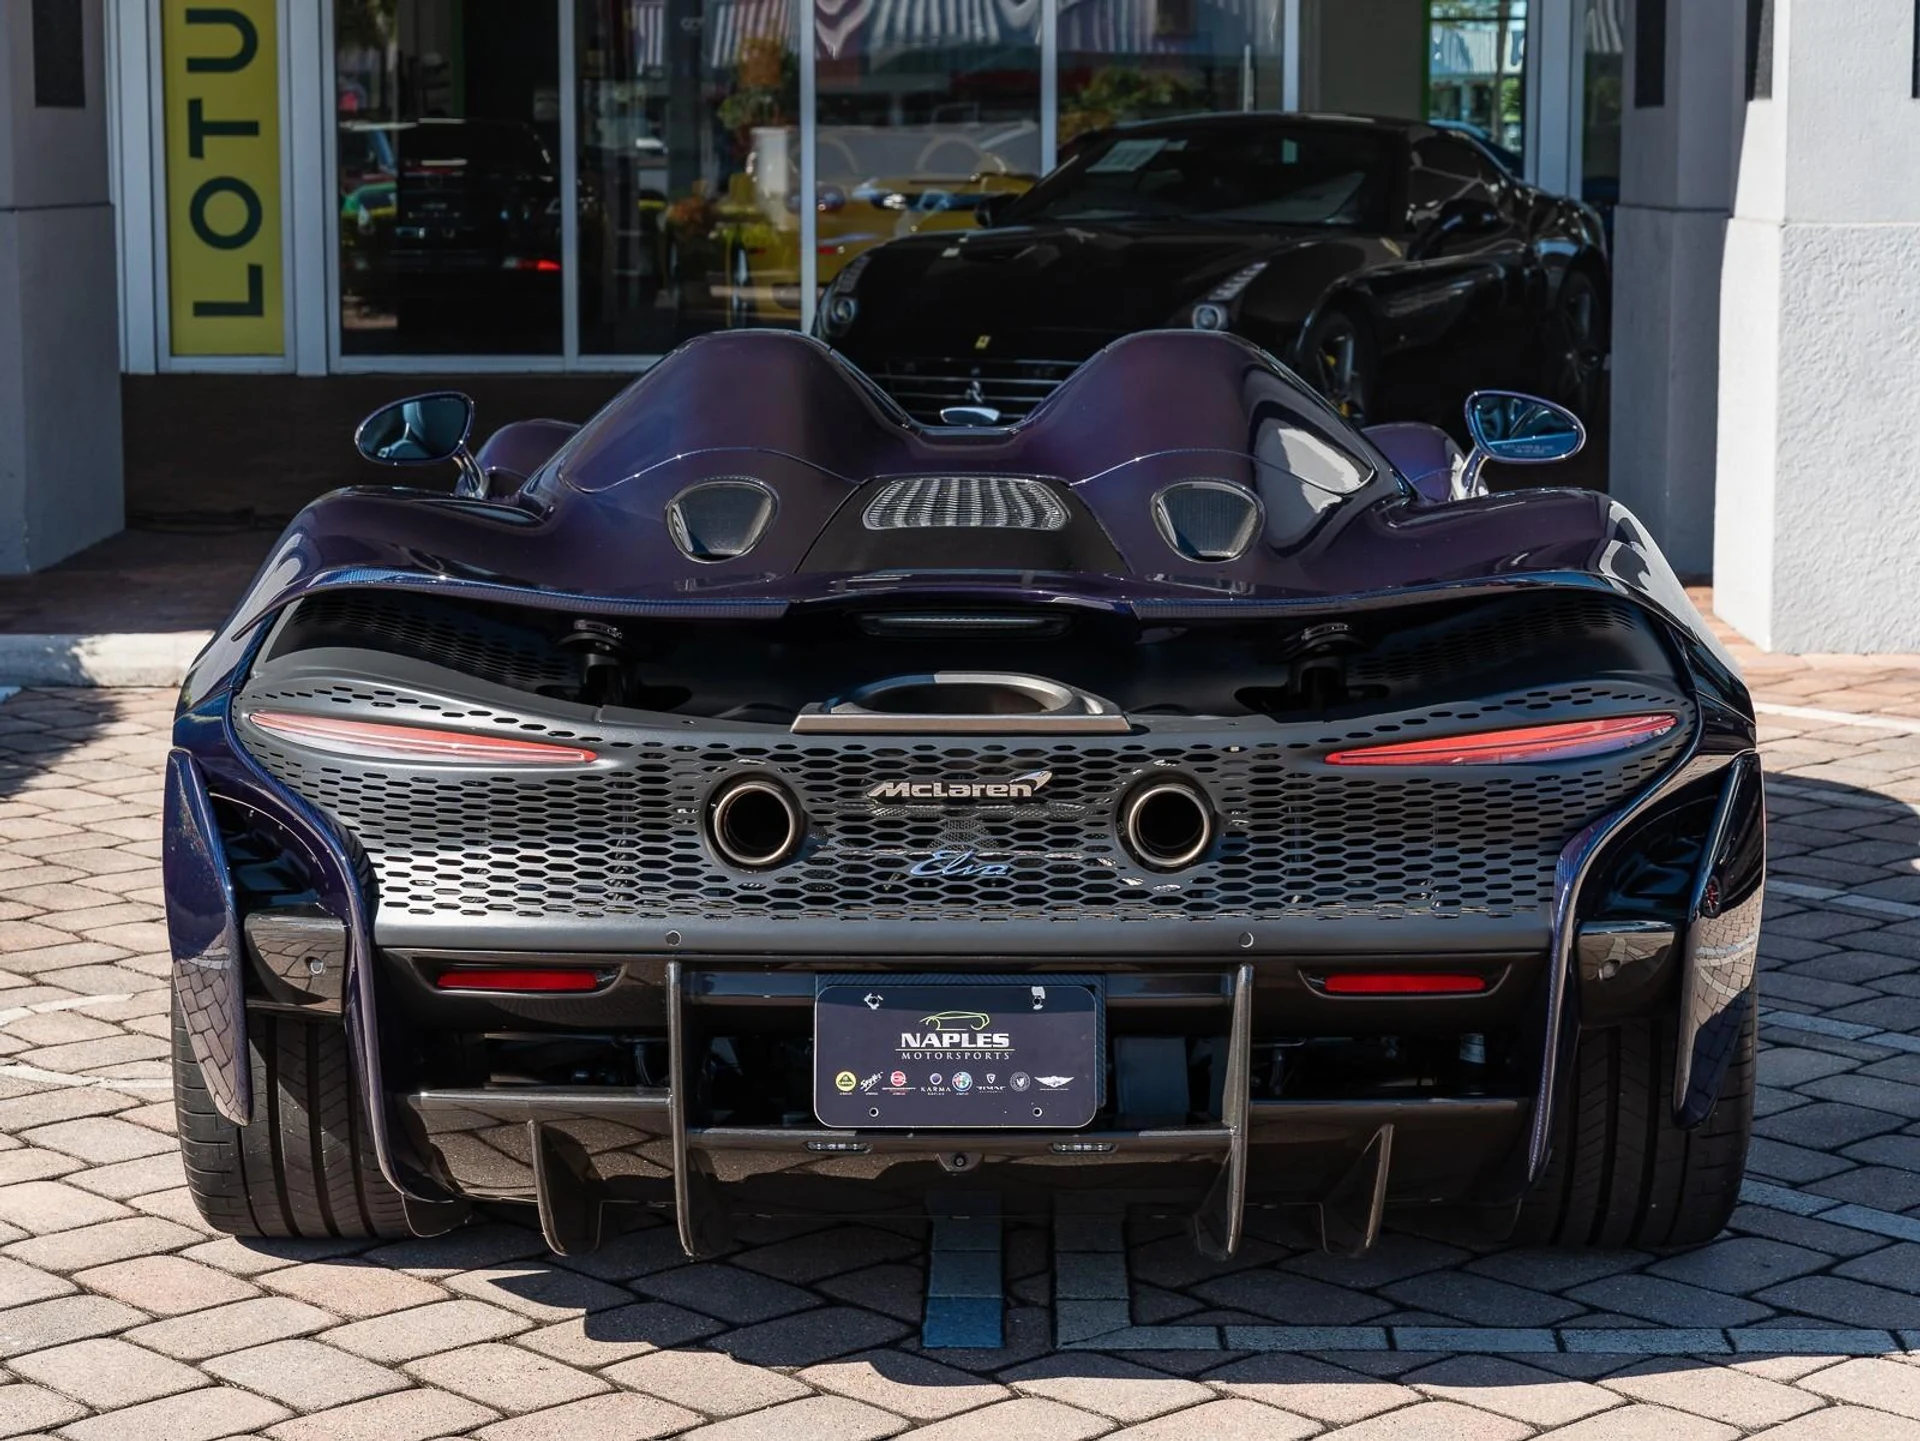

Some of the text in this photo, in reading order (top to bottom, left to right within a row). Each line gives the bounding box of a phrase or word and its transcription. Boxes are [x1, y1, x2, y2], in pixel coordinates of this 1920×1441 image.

[866, 782, 1032, 797] McLaren
[911, 849, 1011, 877] Elva
[901, 1033, 1010, 1048] NAPLES
[901, 1052, 1010, 1060] MOTORSPORTS
